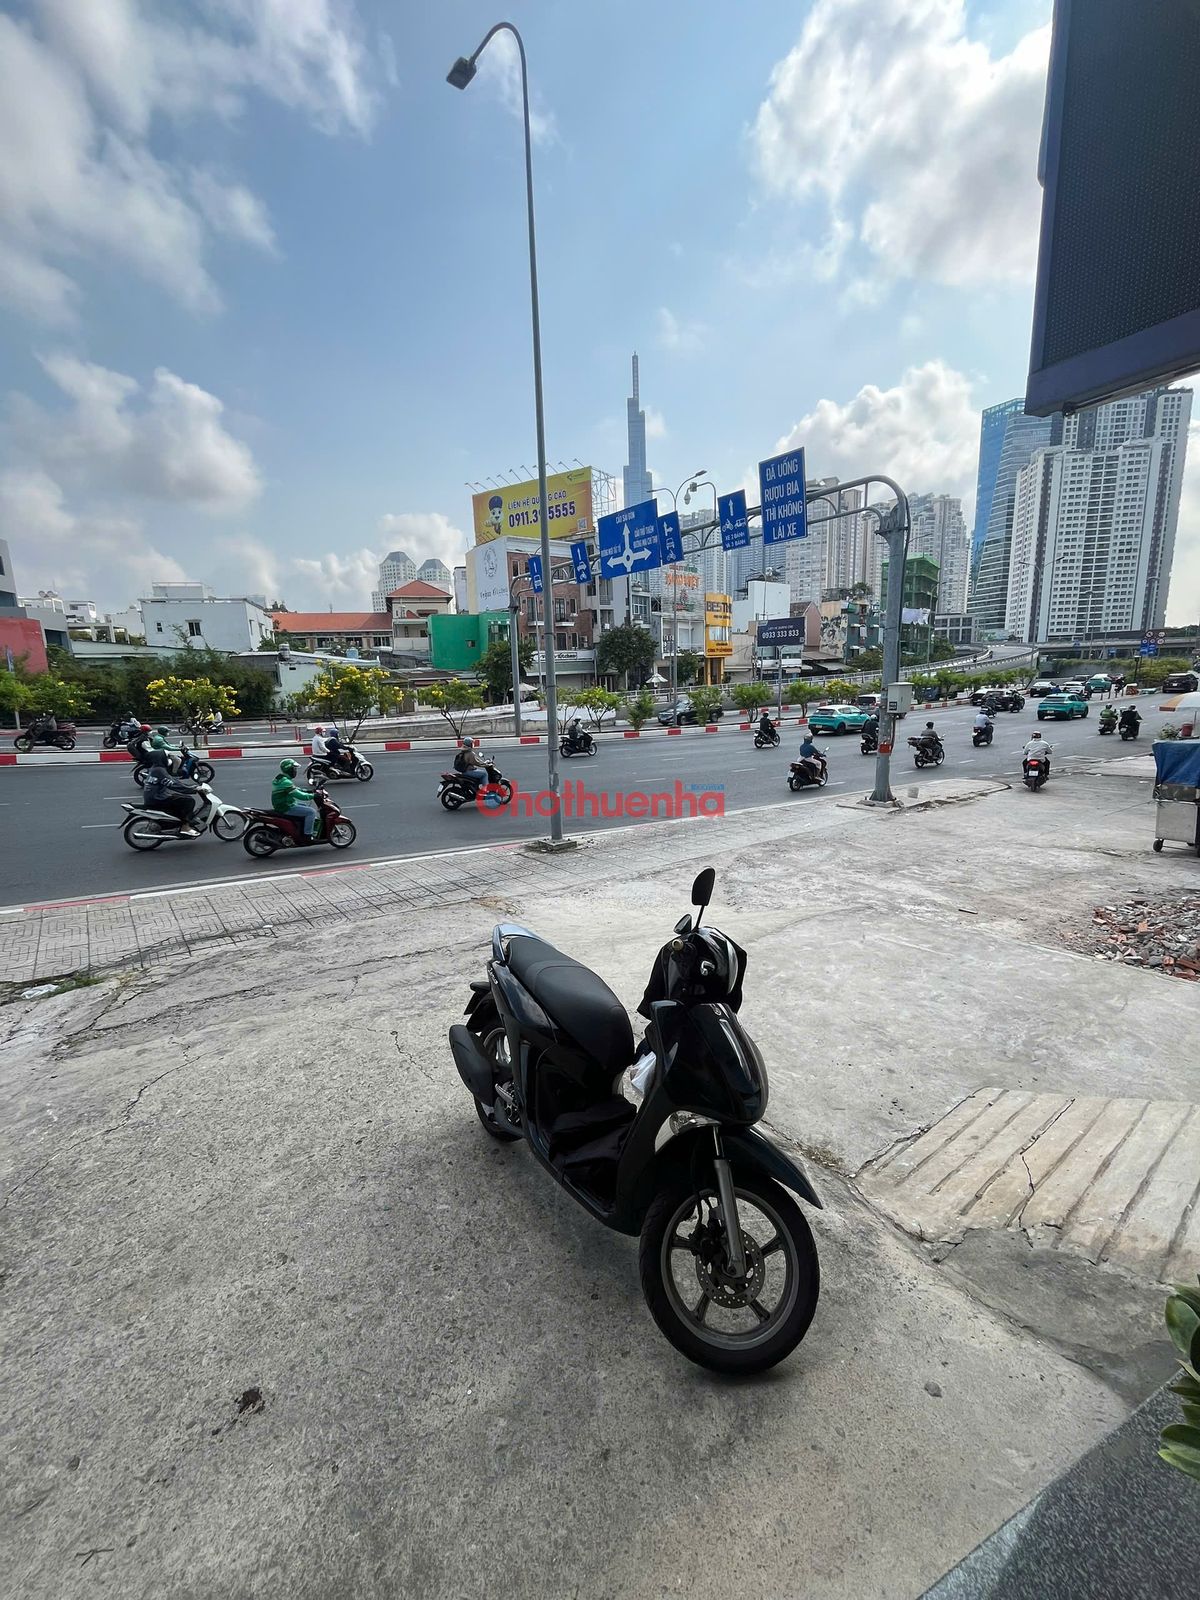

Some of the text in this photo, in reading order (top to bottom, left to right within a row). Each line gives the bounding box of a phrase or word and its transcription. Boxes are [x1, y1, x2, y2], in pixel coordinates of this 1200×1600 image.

[777, 456, 799, 478] UỐNG
[764, 480, 800, 502] RƯỢU BIA
[765, 500, 803, 522] THÌ KHÔNG
[772, 521, 798, 540] LÁI XE
[777, 630, 787, 638] 333
